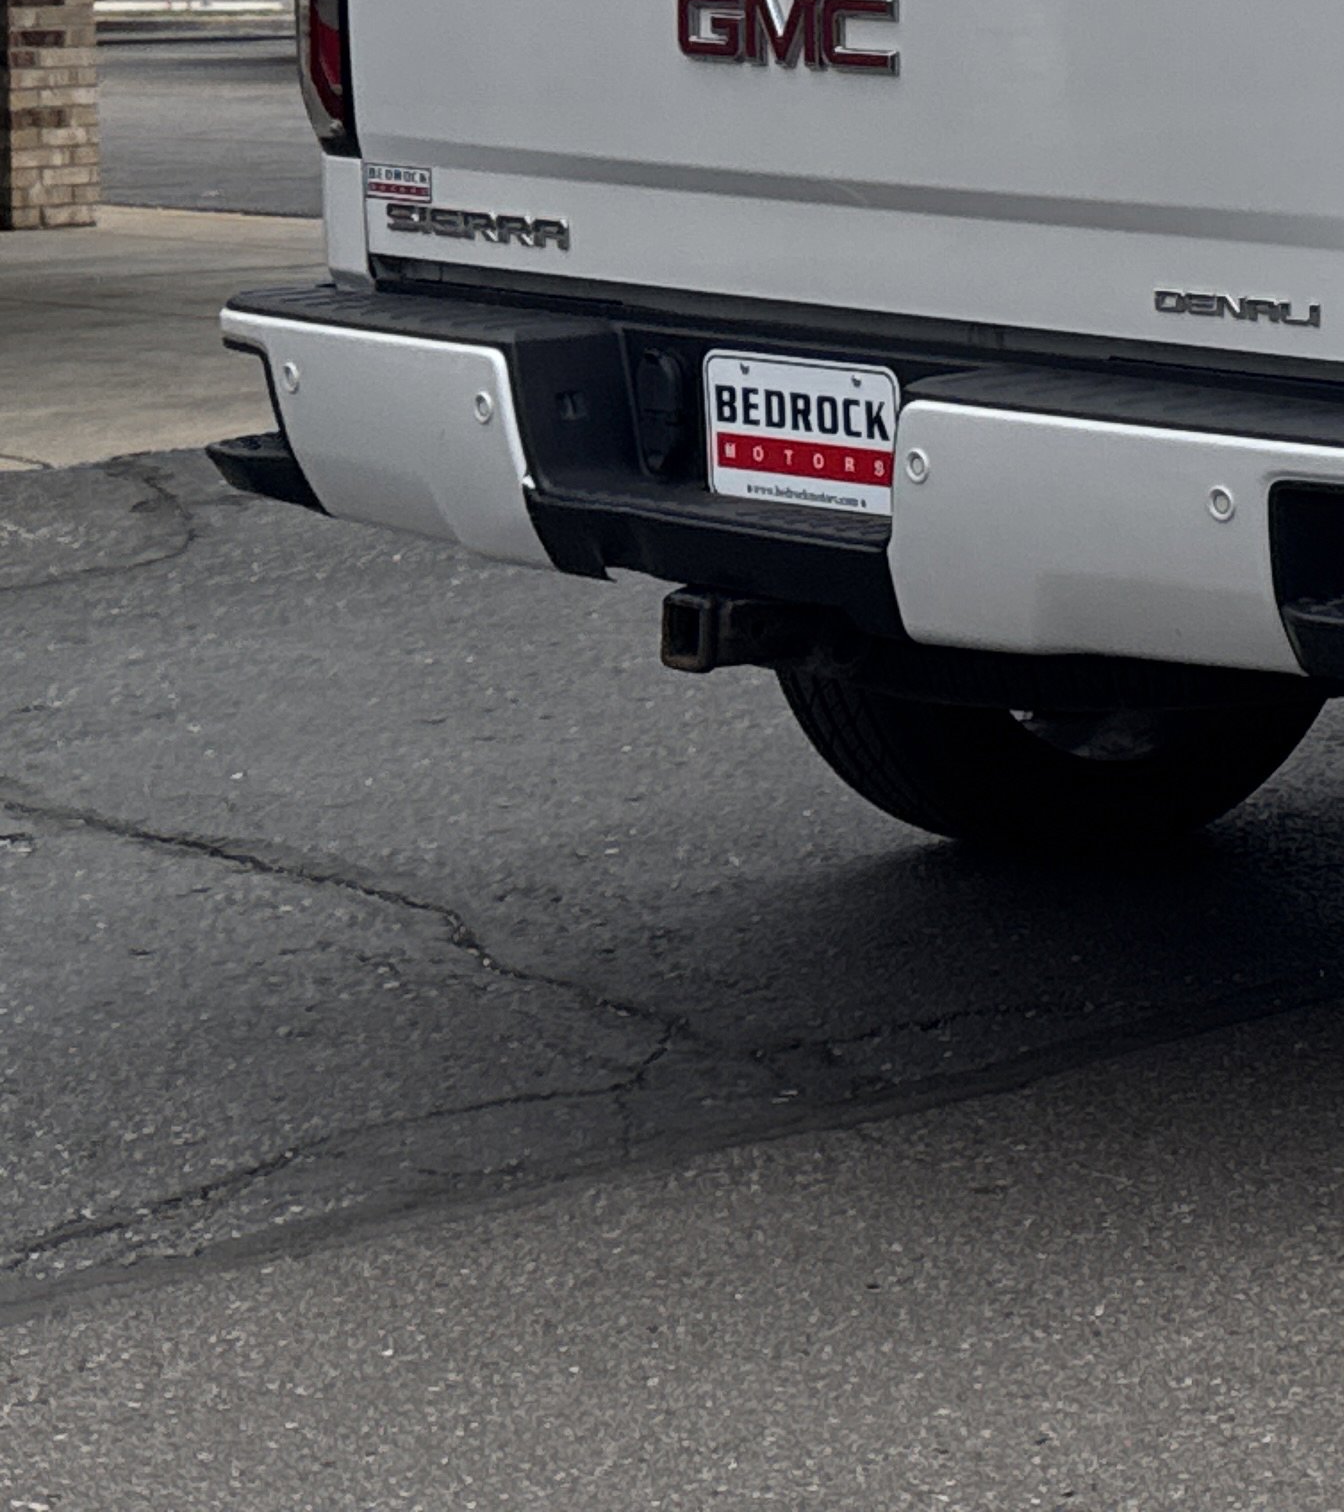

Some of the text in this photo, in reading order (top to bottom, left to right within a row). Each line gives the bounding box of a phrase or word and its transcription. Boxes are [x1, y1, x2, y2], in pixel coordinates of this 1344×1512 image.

[386, 202, 571, 252] SIERRA
[1153, 288, 1321, 329] DENALI
[715, 384, 890, 441] BEDROCK
[724, 442, 886, 477] MOTORS
